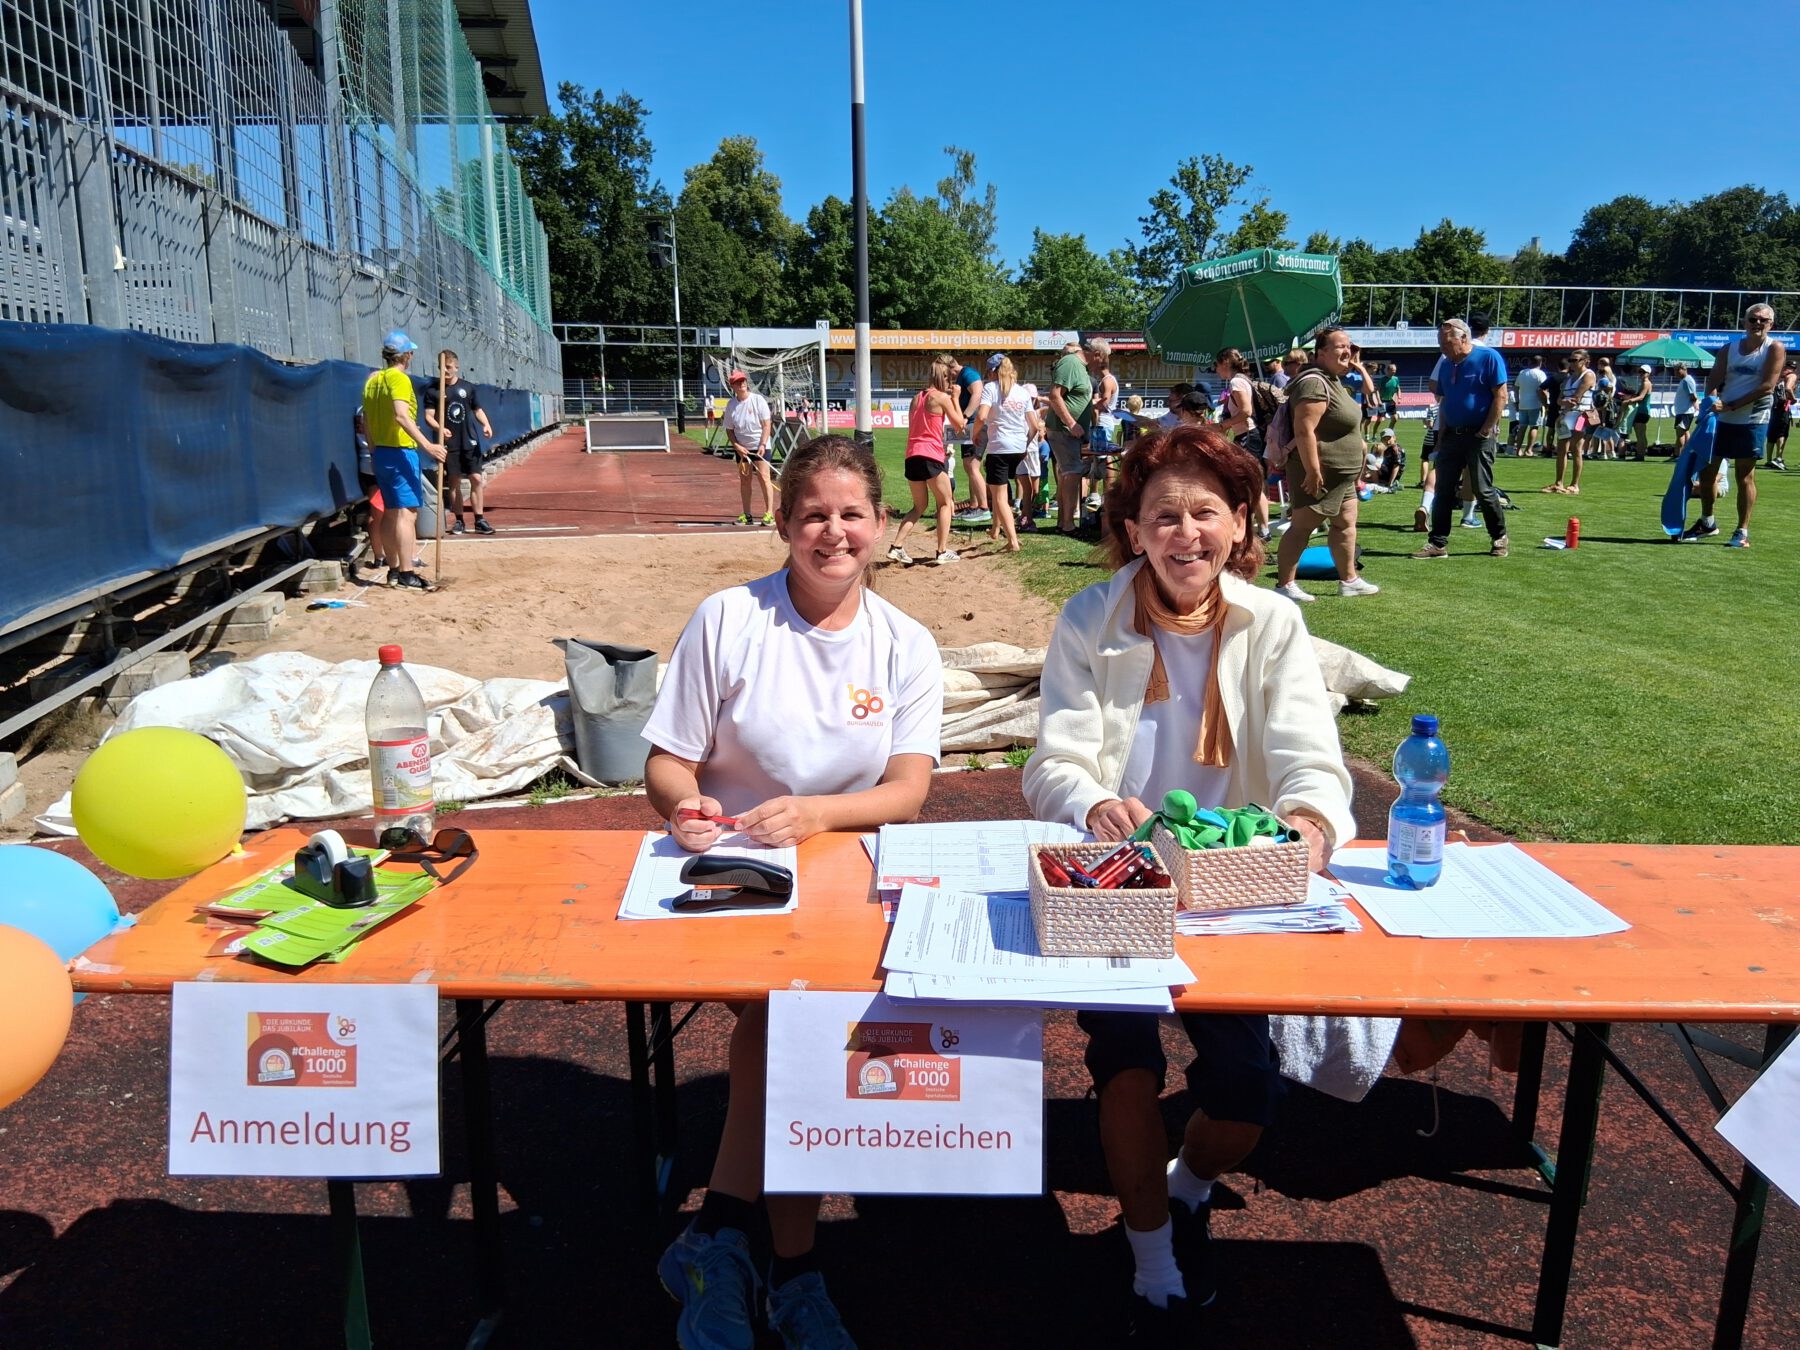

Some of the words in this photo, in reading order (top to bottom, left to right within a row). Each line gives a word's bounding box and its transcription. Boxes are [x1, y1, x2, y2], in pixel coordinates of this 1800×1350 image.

[817, 321, 829, 329] K1
[831, 333, 1033, 346] wwcampus-burghausen.de
[292, 1046, 347, 1058] #Challenge
[306, 1058, 347, 1073] 1000
[893, 1058, 950, 1071] #Challenge
[908, 1071, 950, 1086] 1000
[190, 1111, 411, 1153] Anmeldung
[788, 1120, 1012, 1152] Sportabzeichen
